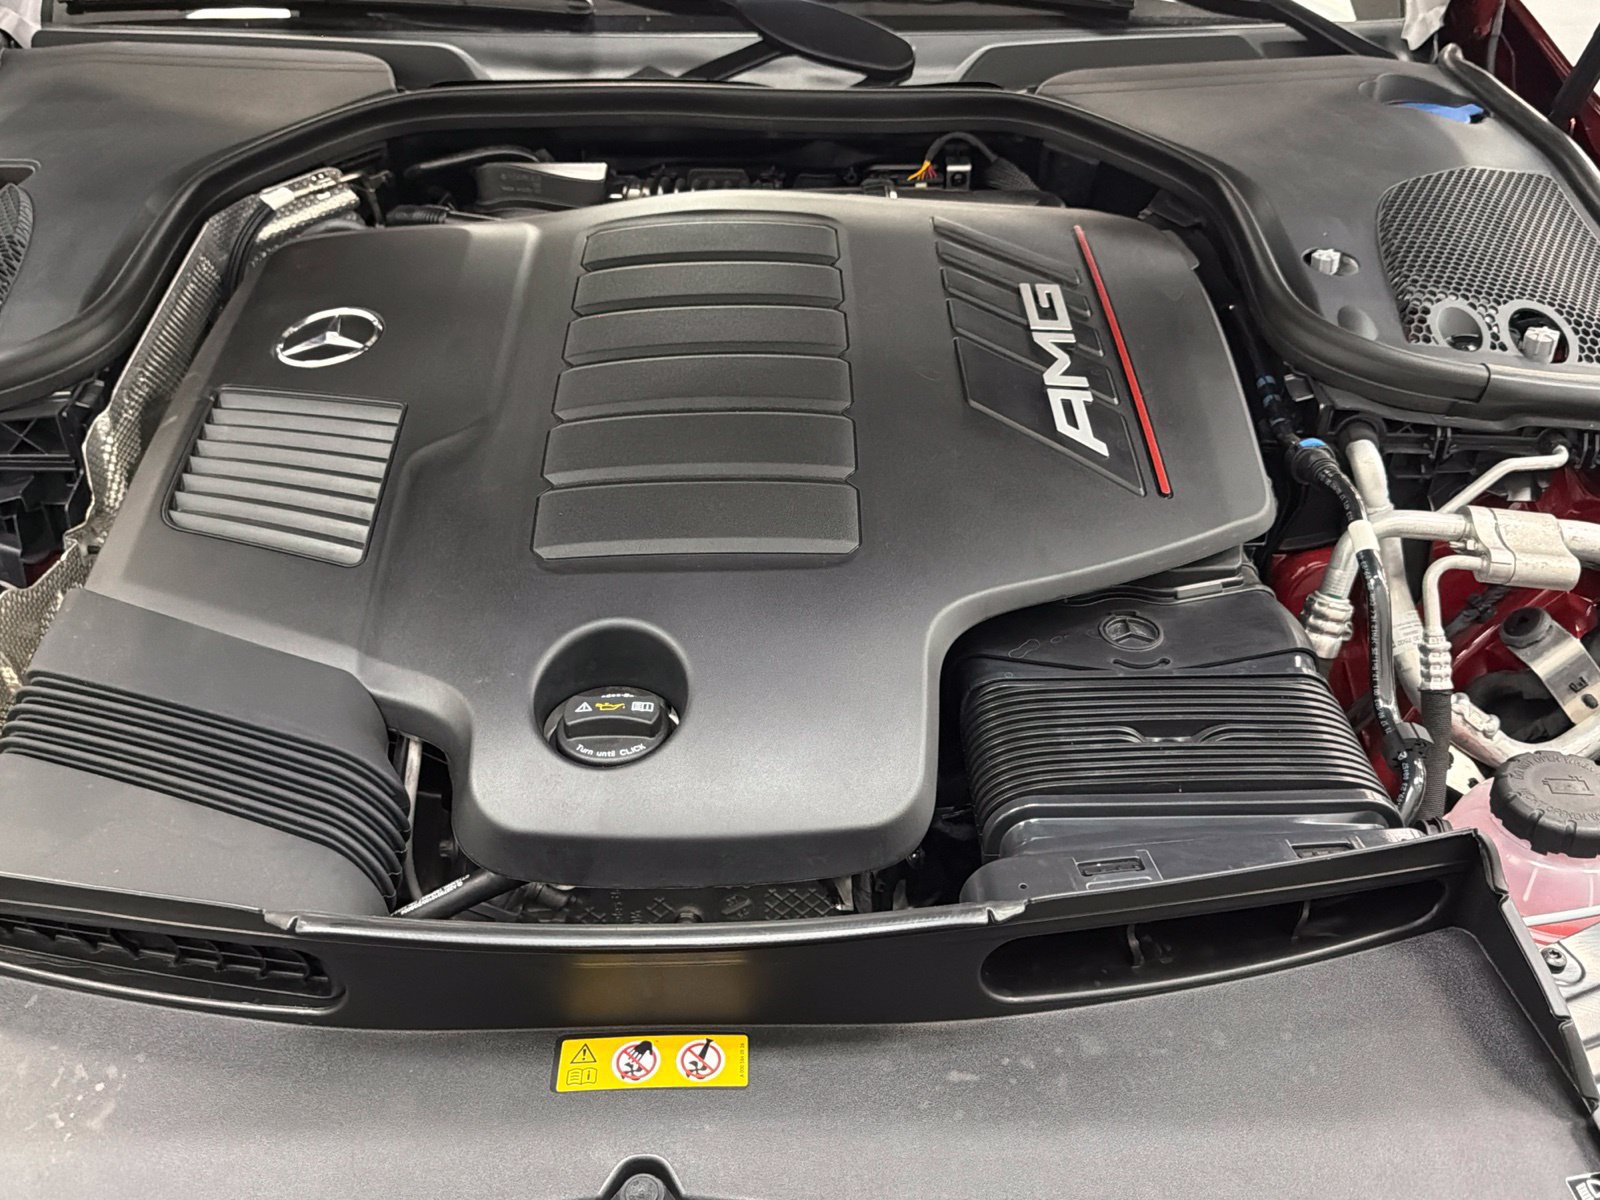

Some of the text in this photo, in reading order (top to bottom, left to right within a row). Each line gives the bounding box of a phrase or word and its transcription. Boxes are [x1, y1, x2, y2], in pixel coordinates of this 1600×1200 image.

[1020, 283, 1109, 457] AMG
[575, 743, 647, 757] Turn until CLICK
